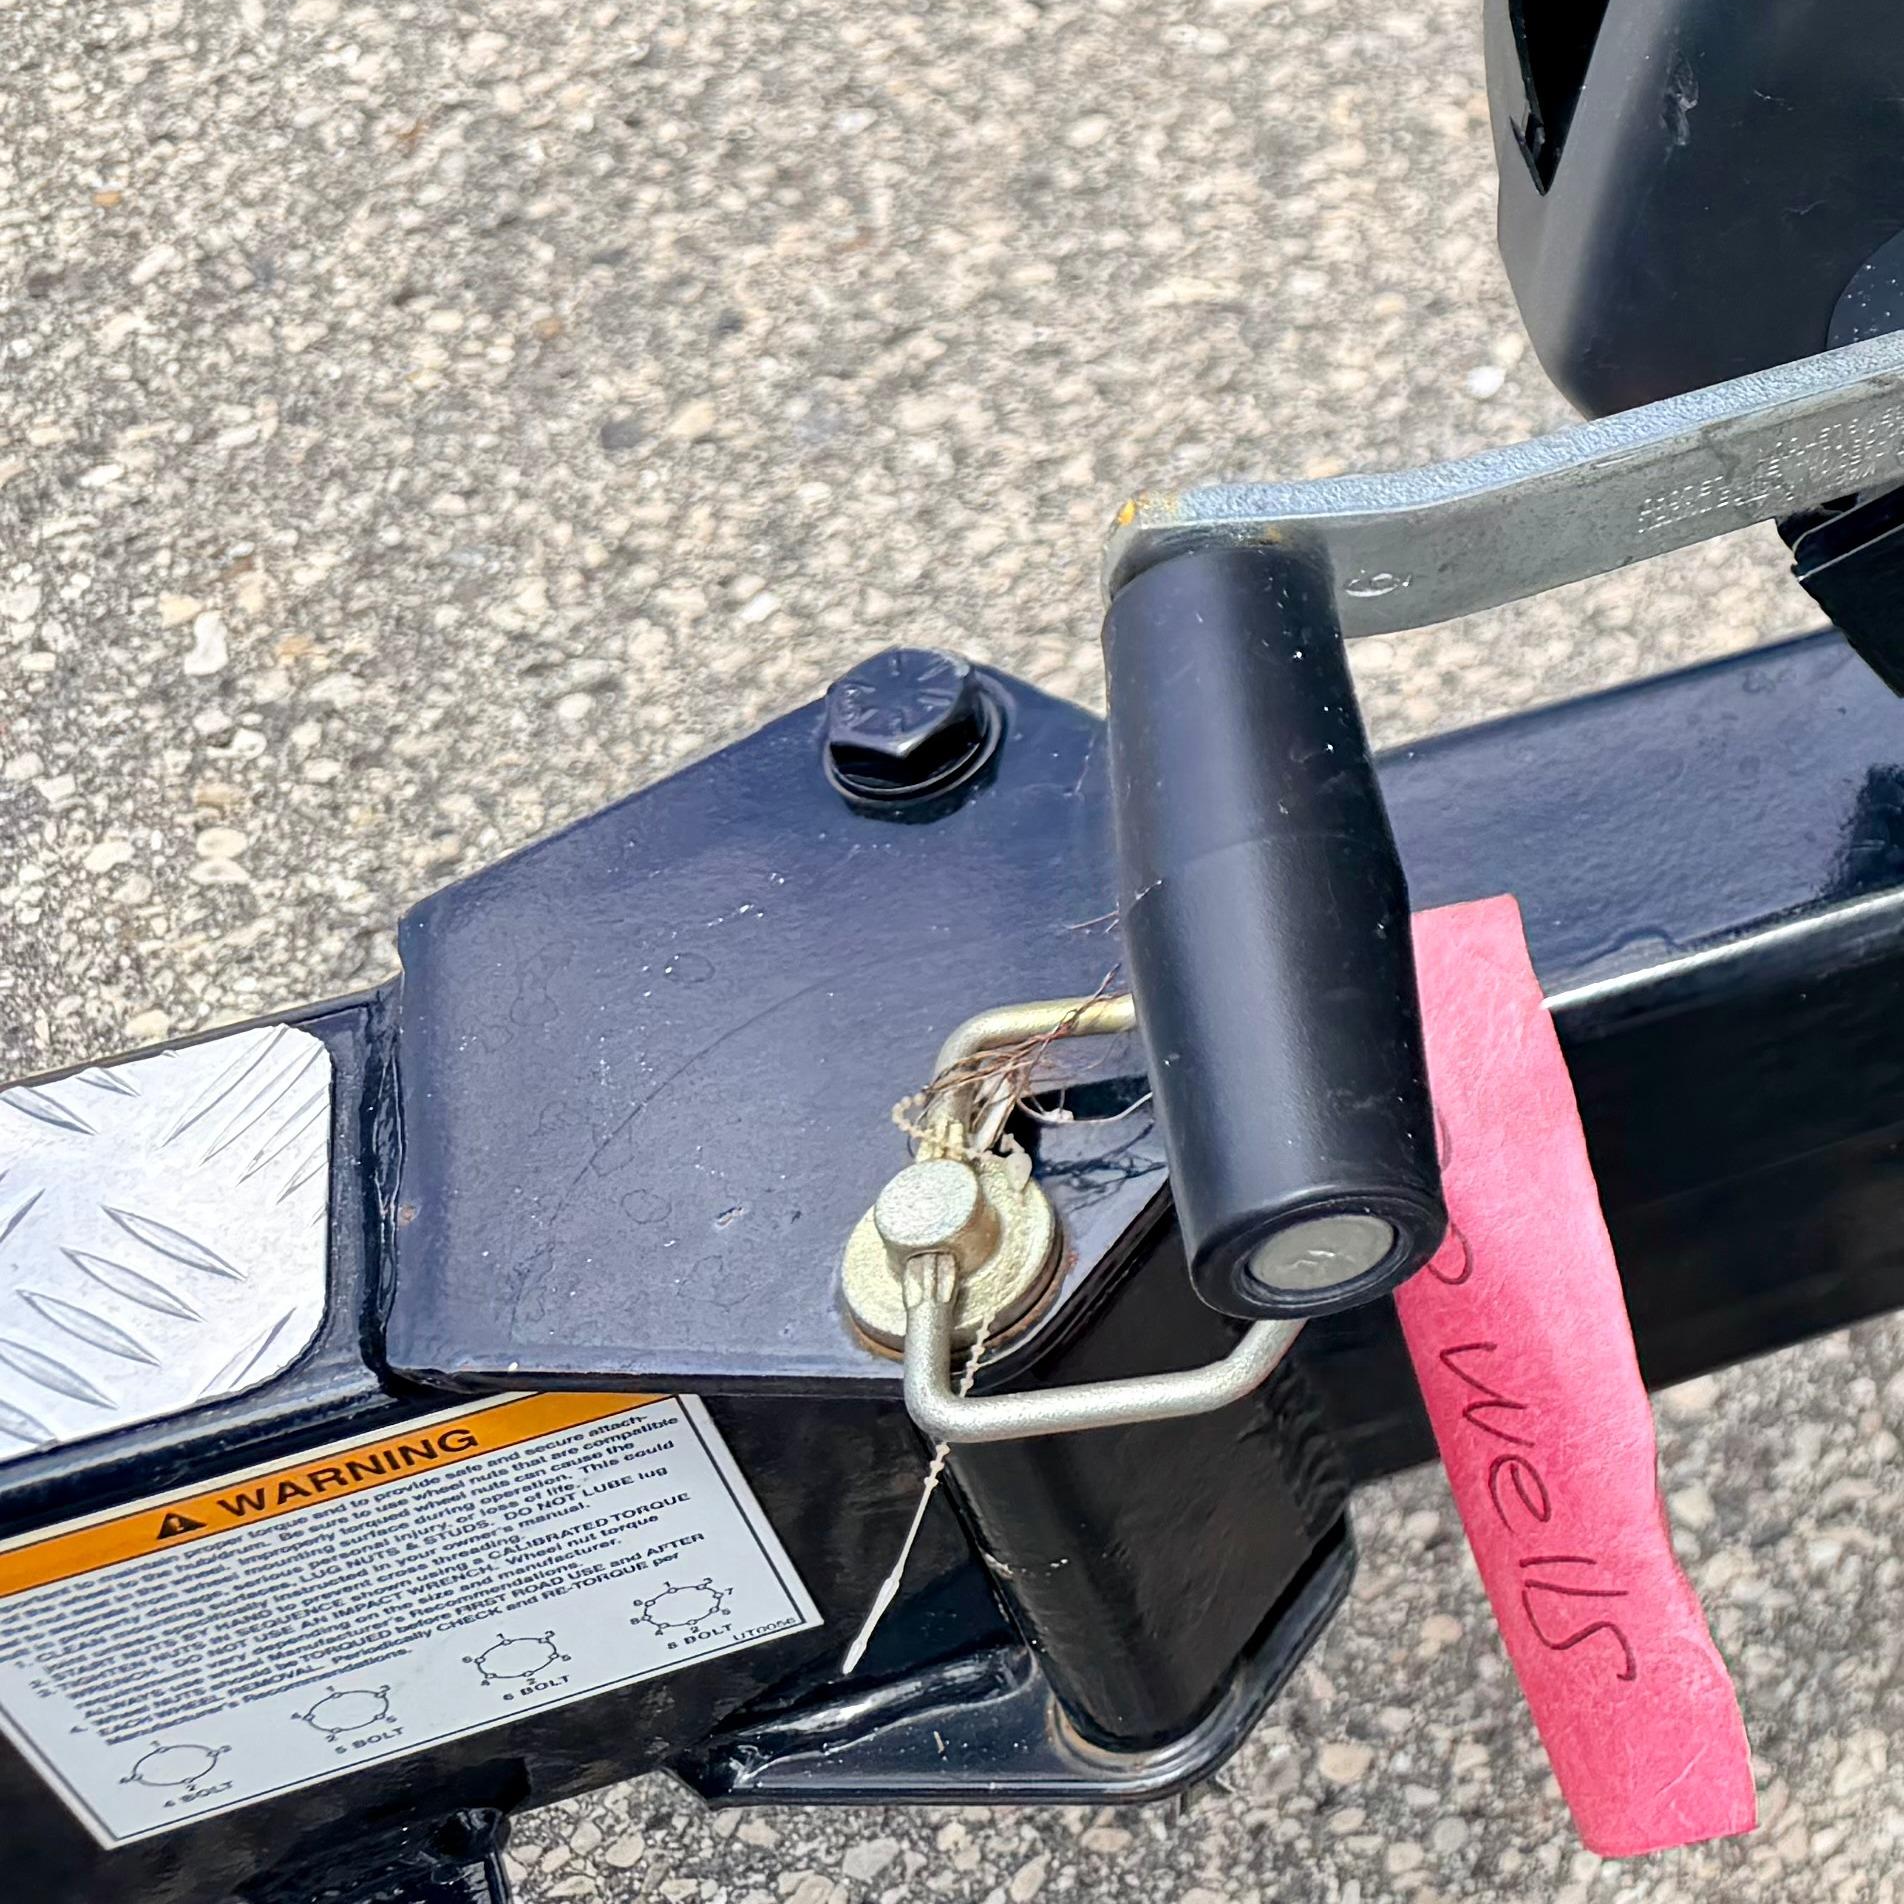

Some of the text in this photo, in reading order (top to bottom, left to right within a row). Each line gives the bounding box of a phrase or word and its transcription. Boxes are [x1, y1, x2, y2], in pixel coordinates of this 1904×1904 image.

[182, 1572, 239, 1593] wheel
[244, 1545, 334, 1575] mounting
[339, 1522, 408, 1546] surface
[414, 1502, 474, 1524] during
[480, 1474, 571, 1504] operation.
[579, 1459, 619, 1473] This
[623, 1440, 673, 1460] could
[183, 1416, 646, 1559] proper torque and to provide safe and secure attach-
[218, 1429, 476, 1515] WARNING
[238, 1442, 633, 1565] Improperly torqued wheel nuts can cause the
[278, 1530, 304, 1541] Be
[308, 1517, 348, 1532] sure
[351, 1510, 371, 1518] to
[375, 1498, 408, 1512] use
[412, 1480, 464, 1500] wheel
[469, 1468, 508, 1484] nuts
[511, 1456, 547, 1470] that
[551, 1447, 578, 1459] are
[583, 1418, 677, 1449] compatible
[299, 1565, 341, 1582] LUG
[345, 1547, 399, 1568] NUTS
[423, 1520, 493, 1544] STUDS.
[503, 1507, 532, 1520] DO
[537, 1492, 574, 1510] NOT
[582, 1476, 633, 1496] LUBE
[638, 1467, 667, 1479] lug
[214, 1609, 272, 1631] HAND
[275, 1603, 296, 1612] to
[301, 1579, 371, 1606] prevent
[376, 1563, 427, 1582] cross
[432, 1535, 523, 1564] threading.
[232, 1566, 303, 1590] serious
[308, 1538, 389, 1569] personal
[394, 1522, 451, 1542] injury,
[455, 1513, 474, 1523] or
[479, 1501, 518, 1516] loss
[524, 1491, 541, 1502] of
[546, 1484, 580, 1495] life.
[235, 1599, 344, 1636] SEQUENCE
[350, 1579, 411, 1601] shown
[416, 1562, 468, 1581] using
[488, 1518, 607, 1559] CALIBRATED
[610, 1493, 689, 1520] TORQUE
[253, 1625, 294, 1642] USE
[301, 1615, 327, 1629] AN
[332, 1591, 401, 1618] IMPACT
[406, 1564, 498, 1594] WRENCH.
[505, 1542, 561, 1564] Wheel
[567, 1533, 596, 1546] nut
[600, 1515, 657, 1536] torque
[273, 1568, 368, 1602] instructed
[372, 1563, 391, 1571] in
[395, 1548, 435, 1566] your
[442, 1525, 513, 1550] owner's
[518, 1502, 589, 1527] manual.
[252, 1621, 350, 1654] depending
[354, 1612, 379, 1623] on
[382, 1602, 412, 1614] the
[418, 1589, 453, 1603] size
[460, 1575, 493, 1591] and
[498, 1539, 620, 1579] manufacturer.
[267, 1616, 404, 1660] Manufacturer's
[409, 1563, 581, 1617] Recommendations.
[274, 1660, 297, 1670] be
[299, 1630, 391, 1661] TORQUED
[394, 1612, 451, 1633] before
[455, 1593, 505, 1614] FIRST
[511, 1576, 563, 1597] ROAD
[567, 1563, 605, 1579] USE
[610, 1552, 641, 1567] and
[647, 1533, 703, 1556] AFTER
[331, 1629, 431, 1663] Periodically
[436, 1606, 502, 1630] CHECK
[506, 1595, 538, 1610] and
[541, 1561, 647, 1598] RE-TORQUE
[652, 1552, 678, 1566] per
[683, 1623, 730, 1644] BOLT
[242, 1649, 410, 1702] Recommendations.
[520, 1675, 567, 1695] BOLT
